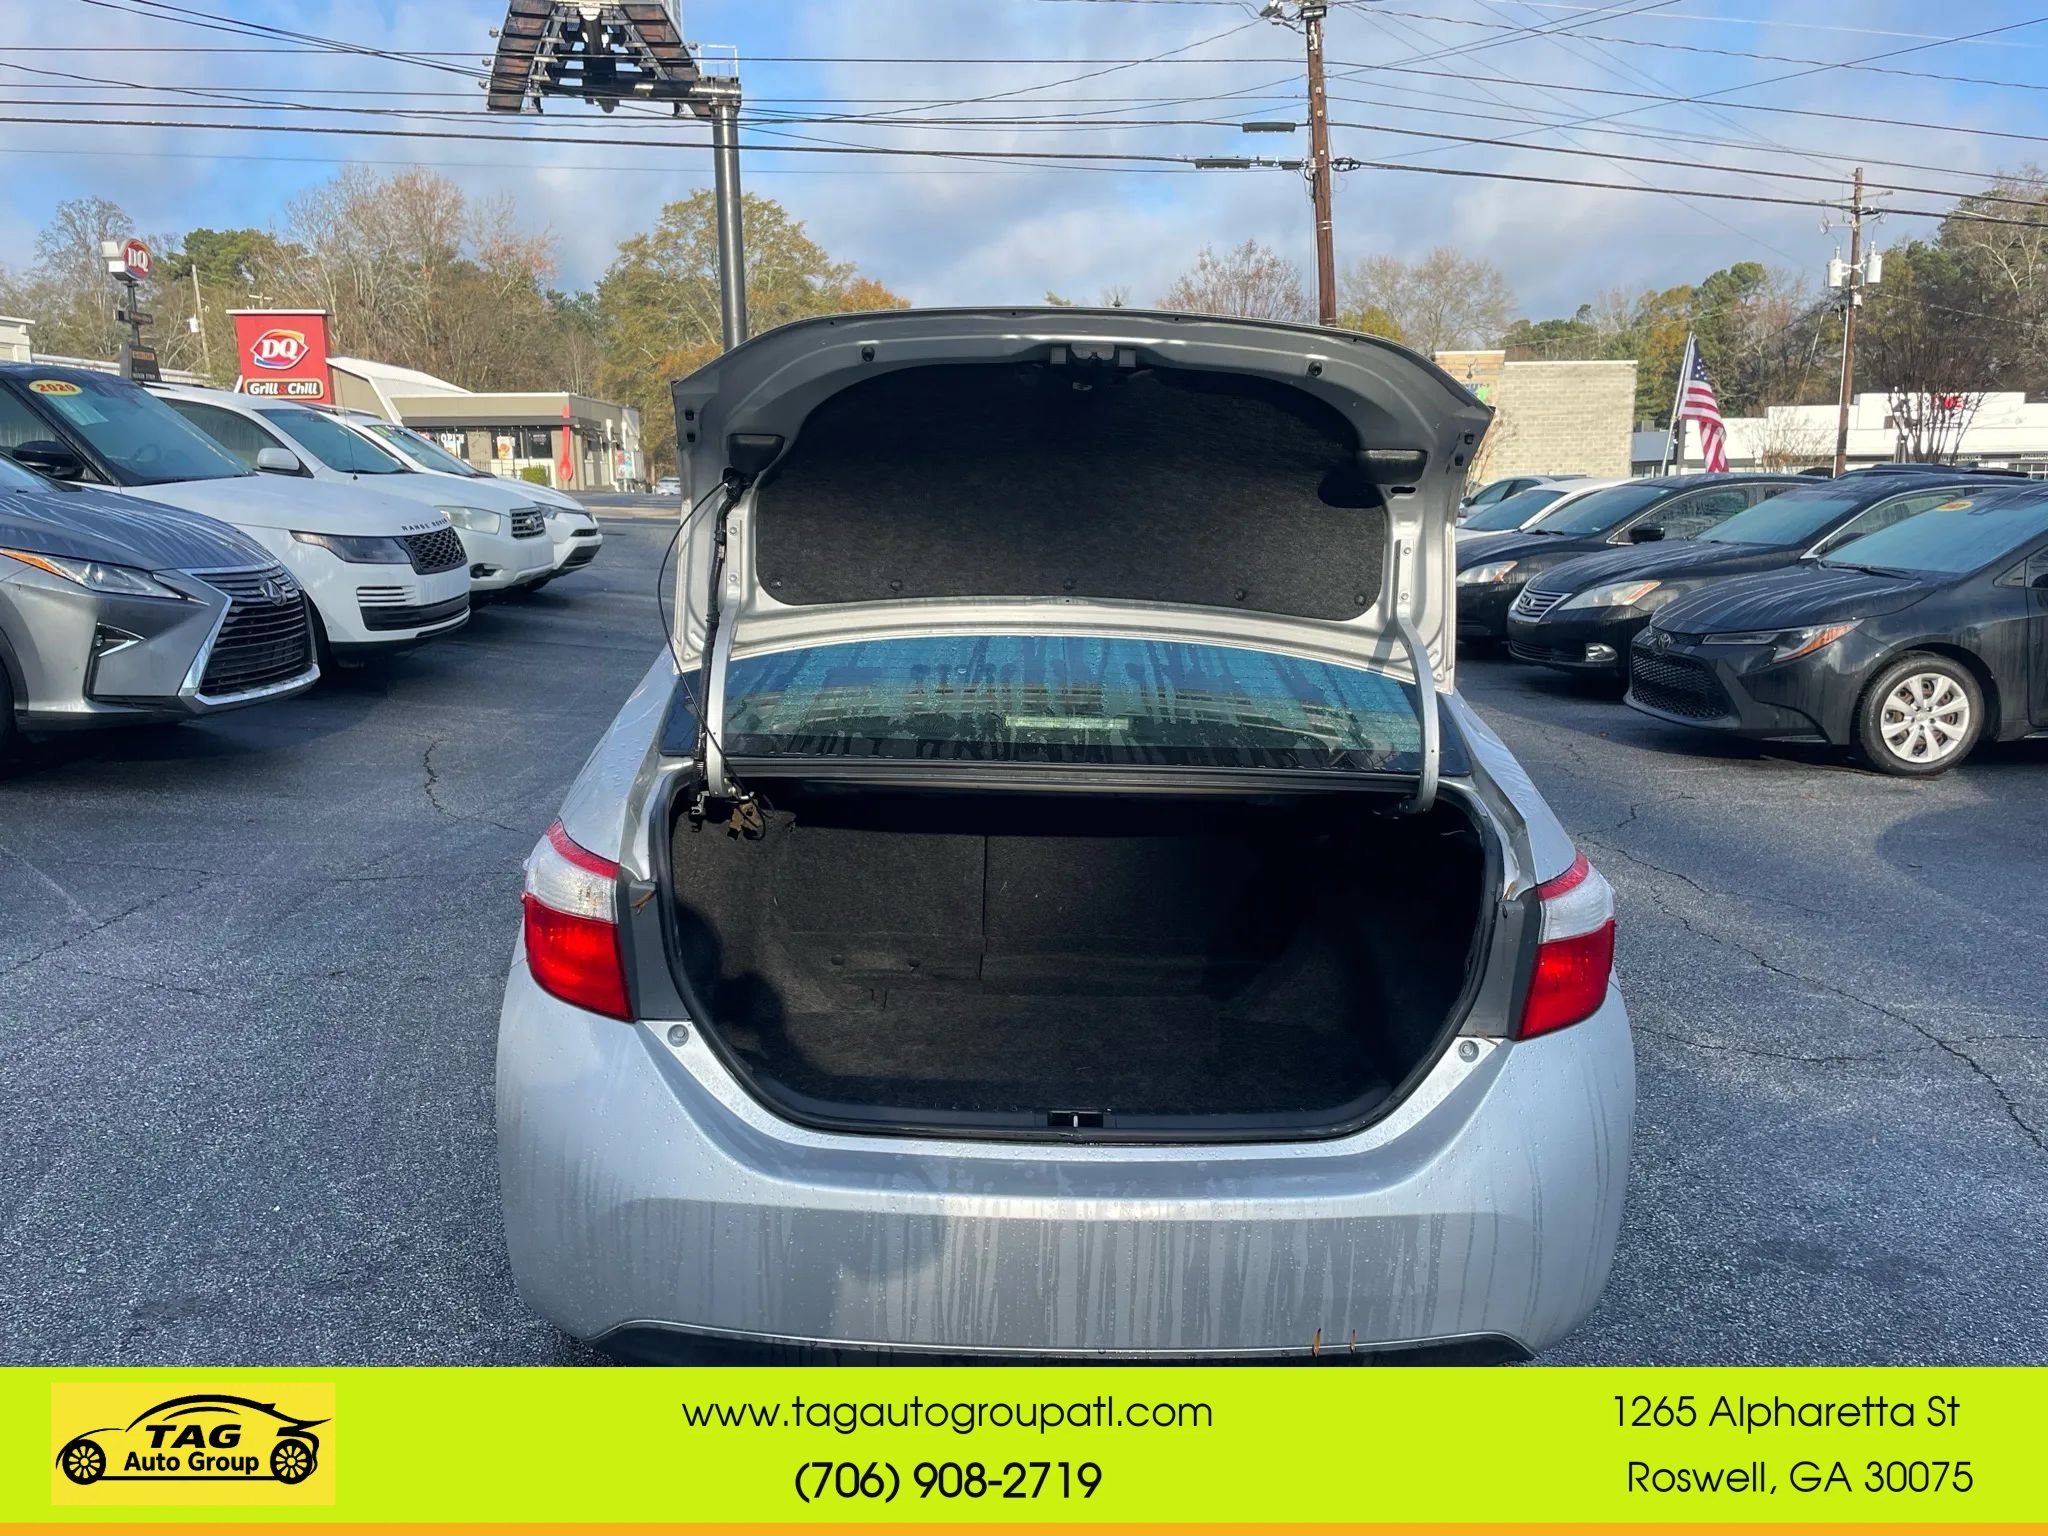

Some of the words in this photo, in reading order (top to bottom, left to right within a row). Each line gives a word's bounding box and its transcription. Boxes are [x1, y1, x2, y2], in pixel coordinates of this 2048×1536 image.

[128, 247, 149, 273] DQ
[262, 338, 299, 361] DQ
[36, 383, 77, 393] 2020
